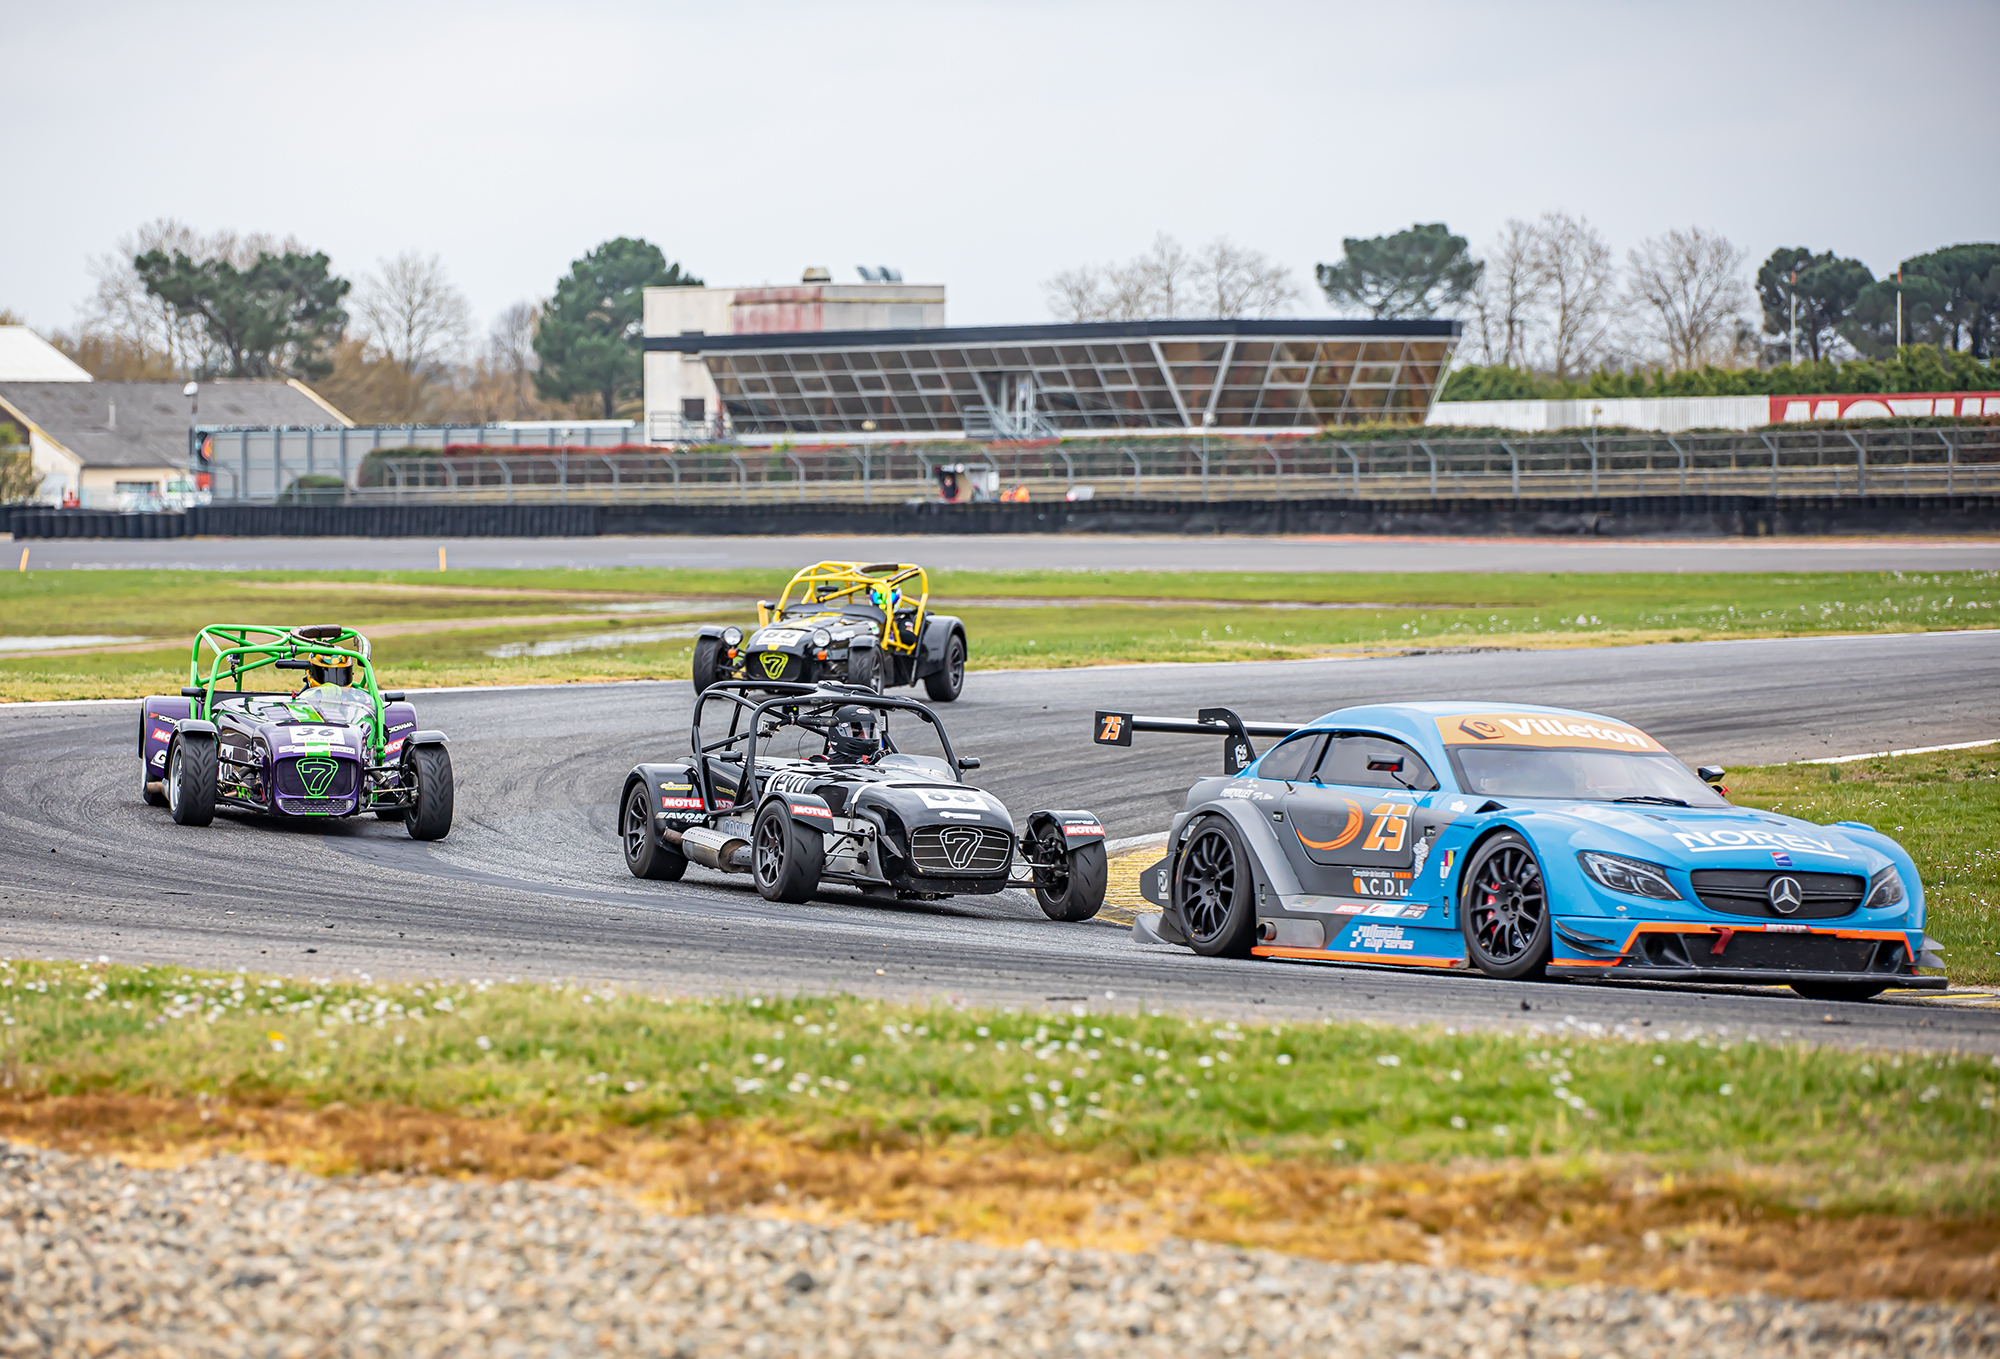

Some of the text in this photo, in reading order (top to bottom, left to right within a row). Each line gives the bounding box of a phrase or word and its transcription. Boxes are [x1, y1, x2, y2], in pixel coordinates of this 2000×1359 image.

[296, 728, 335, 736] 36
[1100, 716, 1122, 740] 25
[1499, 718, 1649, 748] Villeton
[302, 761, 333, 791] 7
[664, 798, 703, 808] MOTUL
[793, 806, 831, 817] MOTUL
[666, 812, 707, 820] AVON
[1066, 826, 1104, 835] MOTUL
[1362, 803, 1414, 852] 25
[945, 831, 978, 864] 7
[1672, 830, 1835, 852] NOREV
[1370, 878, 1413, 896] C.D.L.
